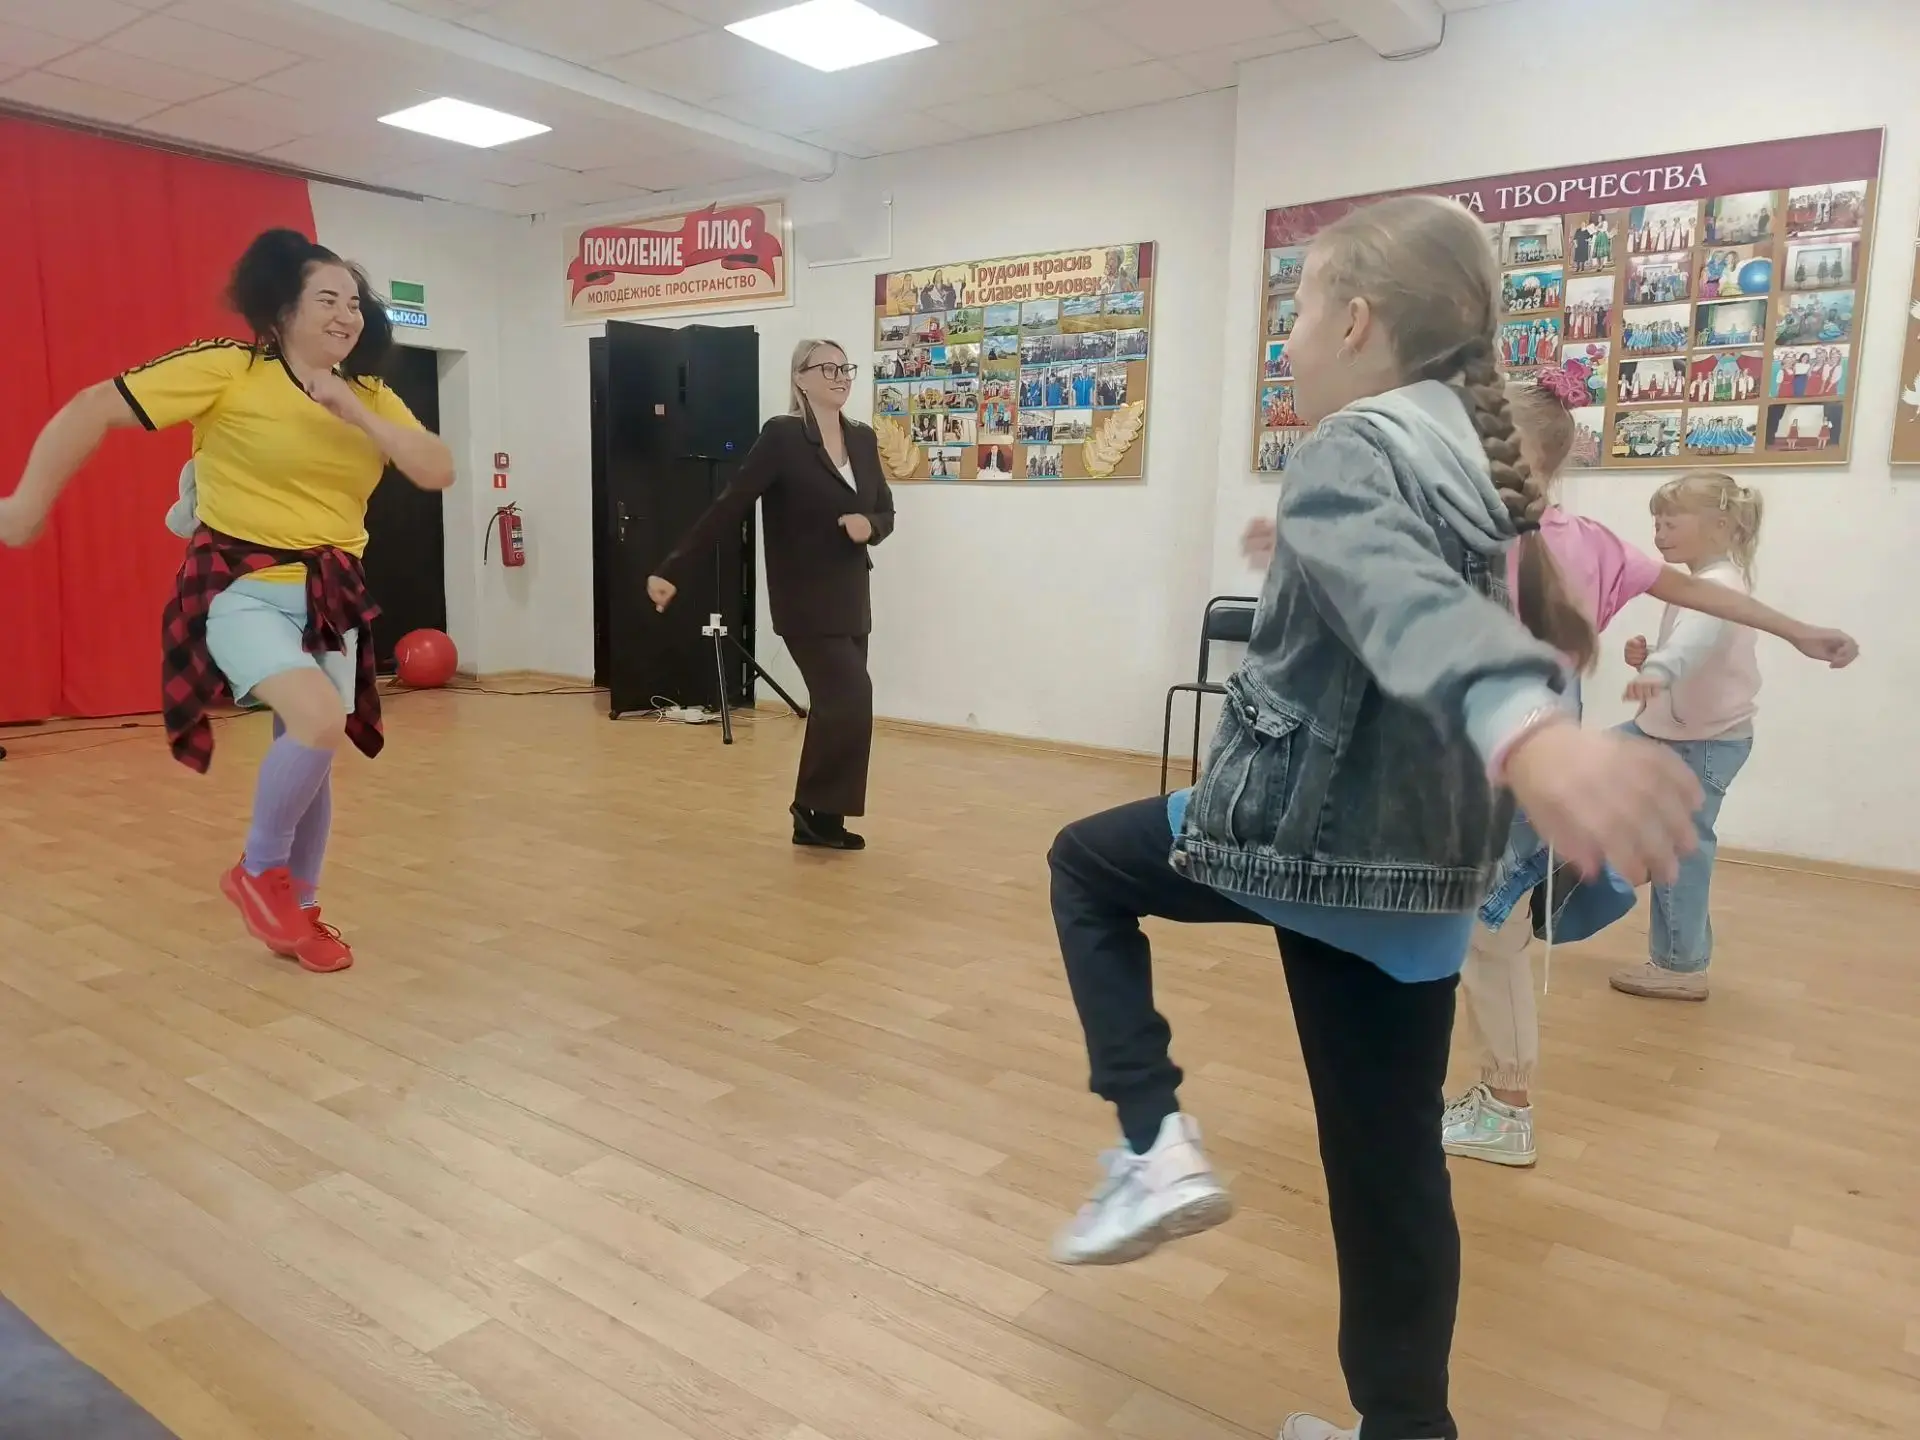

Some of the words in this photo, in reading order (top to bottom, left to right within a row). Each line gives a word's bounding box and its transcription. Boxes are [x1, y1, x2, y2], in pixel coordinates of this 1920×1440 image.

[1496, 163, 1708, 210] ТВОРЧЕСТВА
[584, 237, 683, 266] ПОКОЛЕНИЕ
[697, 218, 752, 250] ПЛЮС
[665, 273, 757, 296] ПРОСТРАНСТВО
[968, 263, 1030, 287] Трудом
[1032, 255, 1093, 280] красив
[965, 290, 976, 305] и
[978, 282, 1032, 303] славен
[1034, 276, 1102, 297] человек
[1508, 298, 1541, 312] 2023
